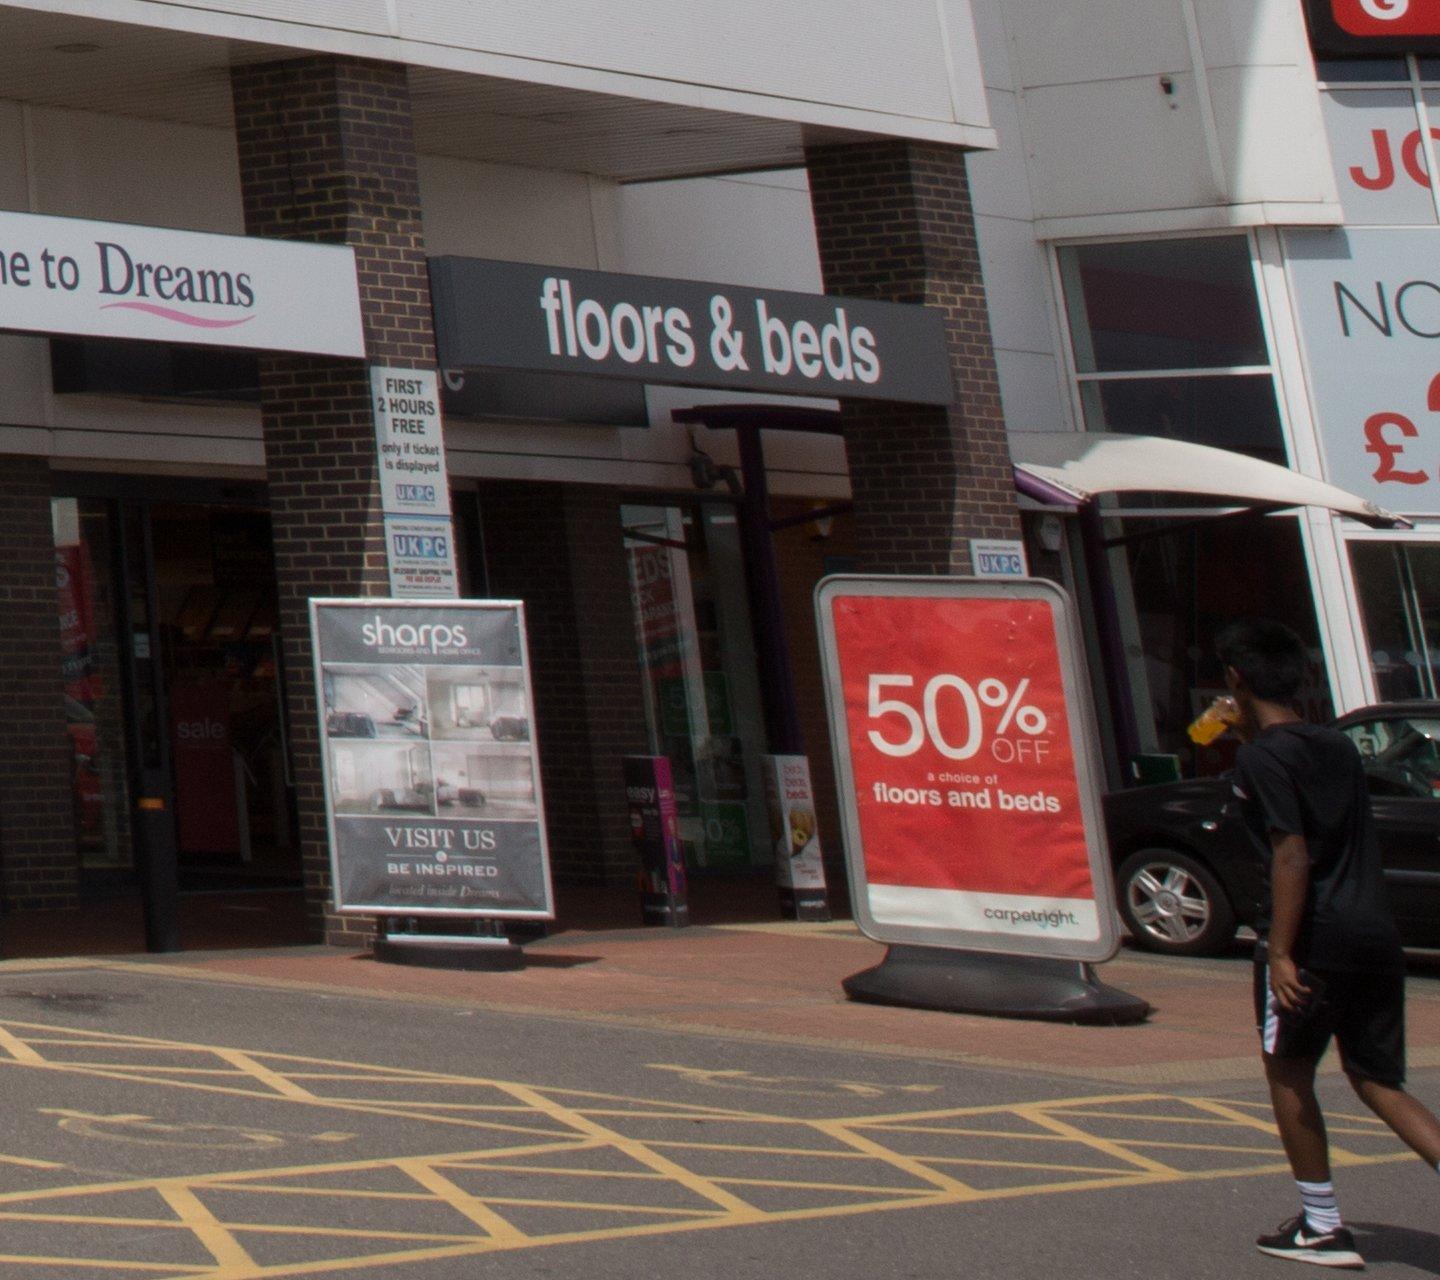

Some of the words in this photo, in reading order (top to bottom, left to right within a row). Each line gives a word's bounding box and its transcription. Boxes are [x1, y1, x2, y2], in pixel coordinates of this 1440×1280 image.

[40, 248, 79, 290] to
[94, 241, 255, 308] Dreams
[540, 277, 695, 367] floors
[710, 295, 750, 371] &
[756, 299, 880, 383] beds
[386, 378, 423, 394] FIRST
[378, 397, 386, 412] 2
[390, 399, 435, 416] HOURS
[392, 418, 426, 435] FREE
[382, 443, 401, 455] only
[403, 443, 410, 453] if
[412, 443, 440, 455] ticket
[385, 458, 393, 469] is
[395, 459, 440, 474] displayed
[395, 484, 435, 501] UKPC
[393, 534, 447, 558] UKPC
[977, 553, 1021, 574] UKPC
[362, 615, 468, 654] sharps
[867, 673, 1048, 760] 50%
[177, 717, 226, 739] sale
[991, 738, 1050, 763] OFF
[927, 773, 935, 781] a
[938, 772, 980, 784] choice
[985, 773, 998, 784] of
[873, 782, 942, 807] floors
[947, 788, 991, 810] and
[999, 788, 1061, 813] beds
[384, 827, 454, 848] VISIT
[461, 830, 496, 851] US
[387, 863, 410, 874] BE
[416, 864, 498, 877] INSPIRED
